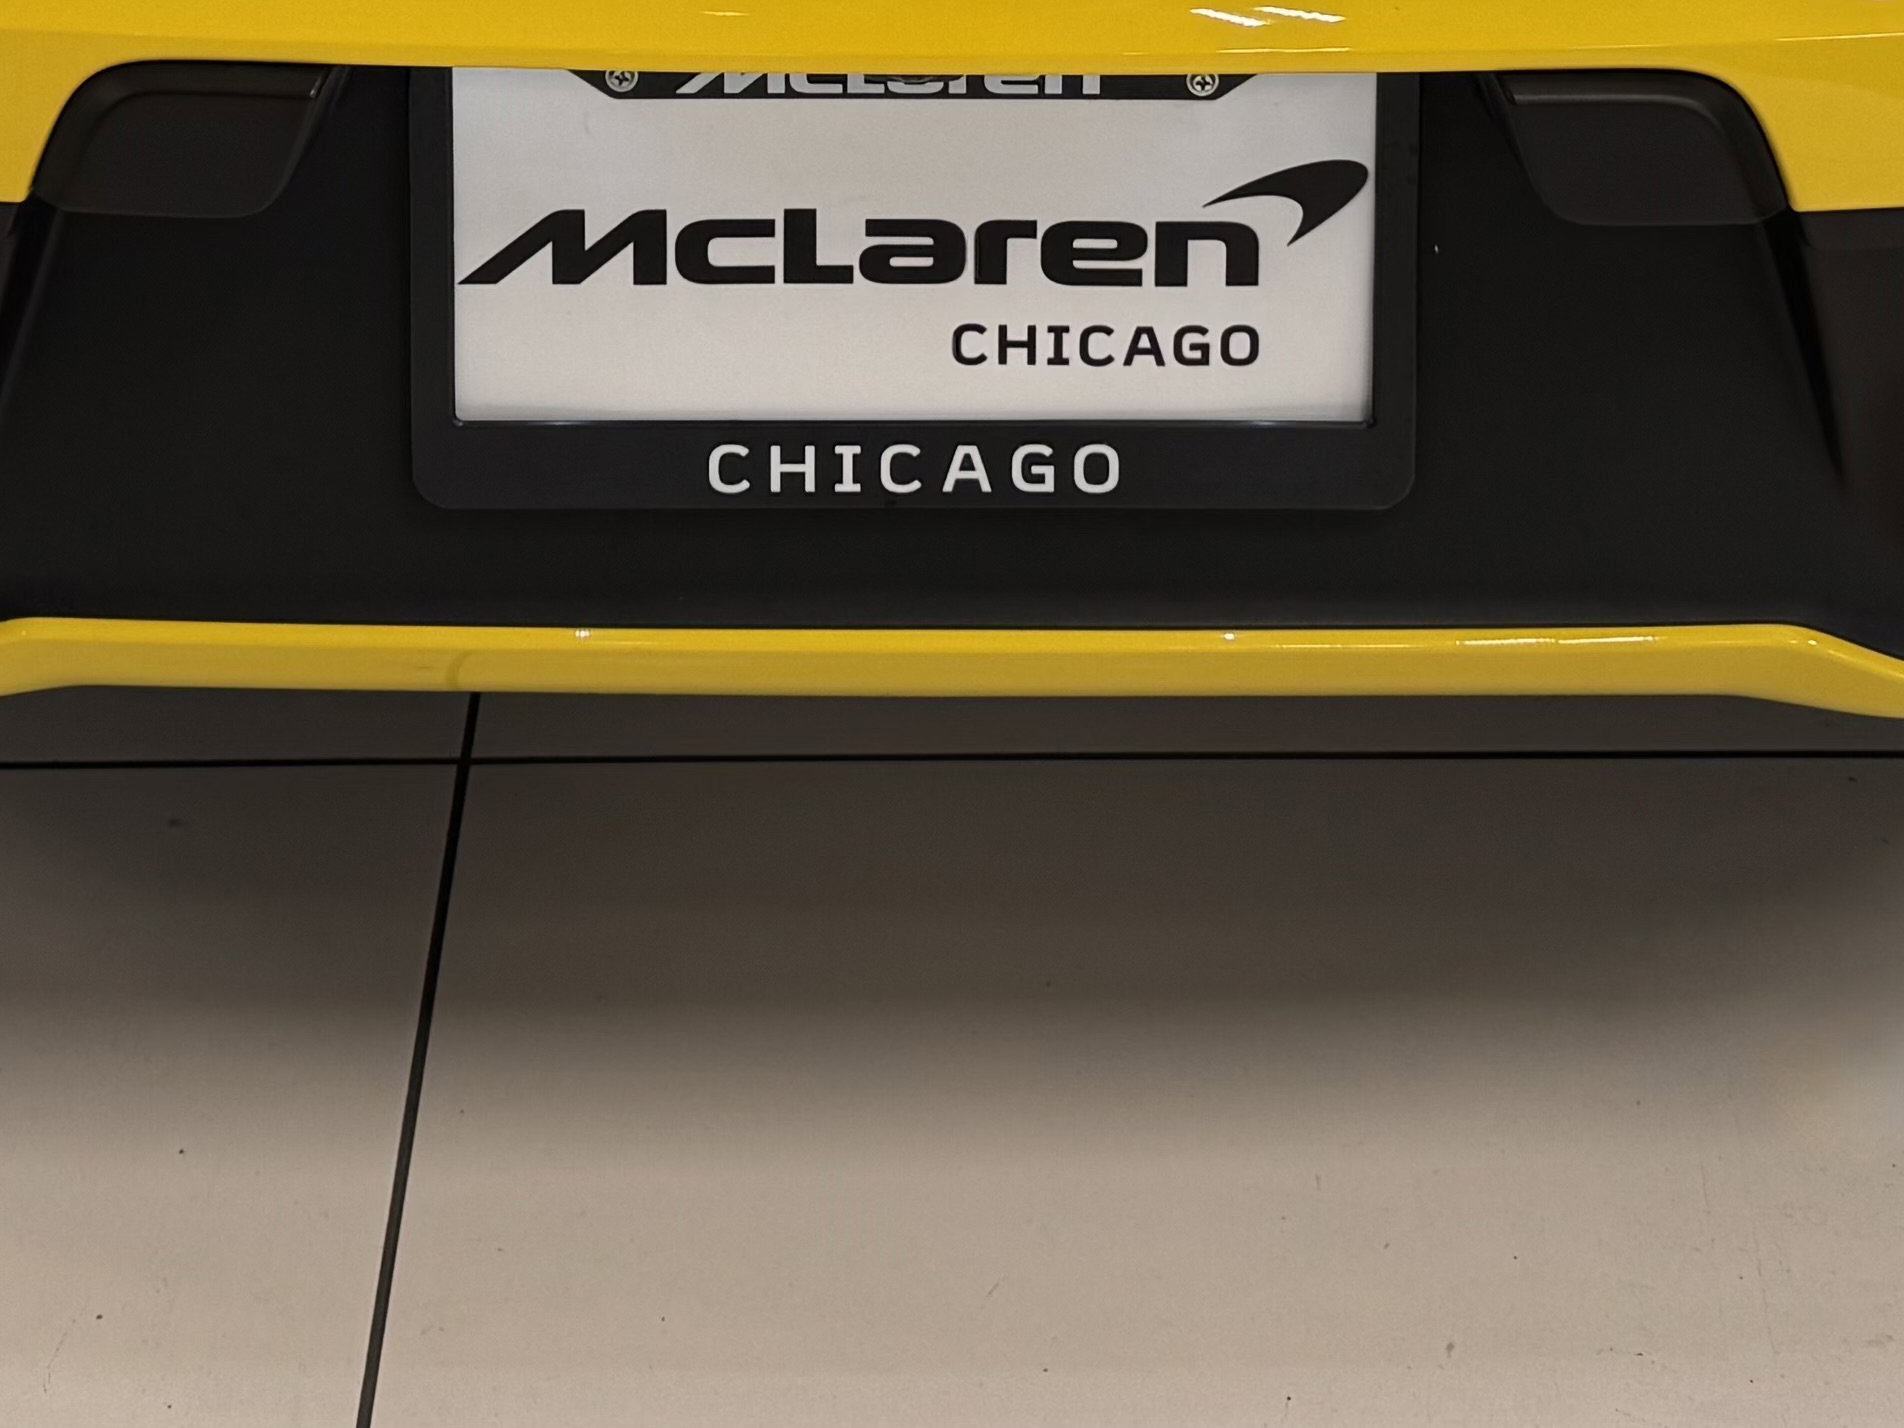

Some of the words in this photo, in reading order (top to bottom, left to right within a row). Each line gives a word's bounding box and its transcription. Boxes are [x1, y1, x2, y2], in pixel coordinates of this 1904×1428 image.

[458, 208, 1261, 287] McLaren
[951, 322, 1260, 367] CHICAGO
[707, 443, 1121, 494] CHICAGO
